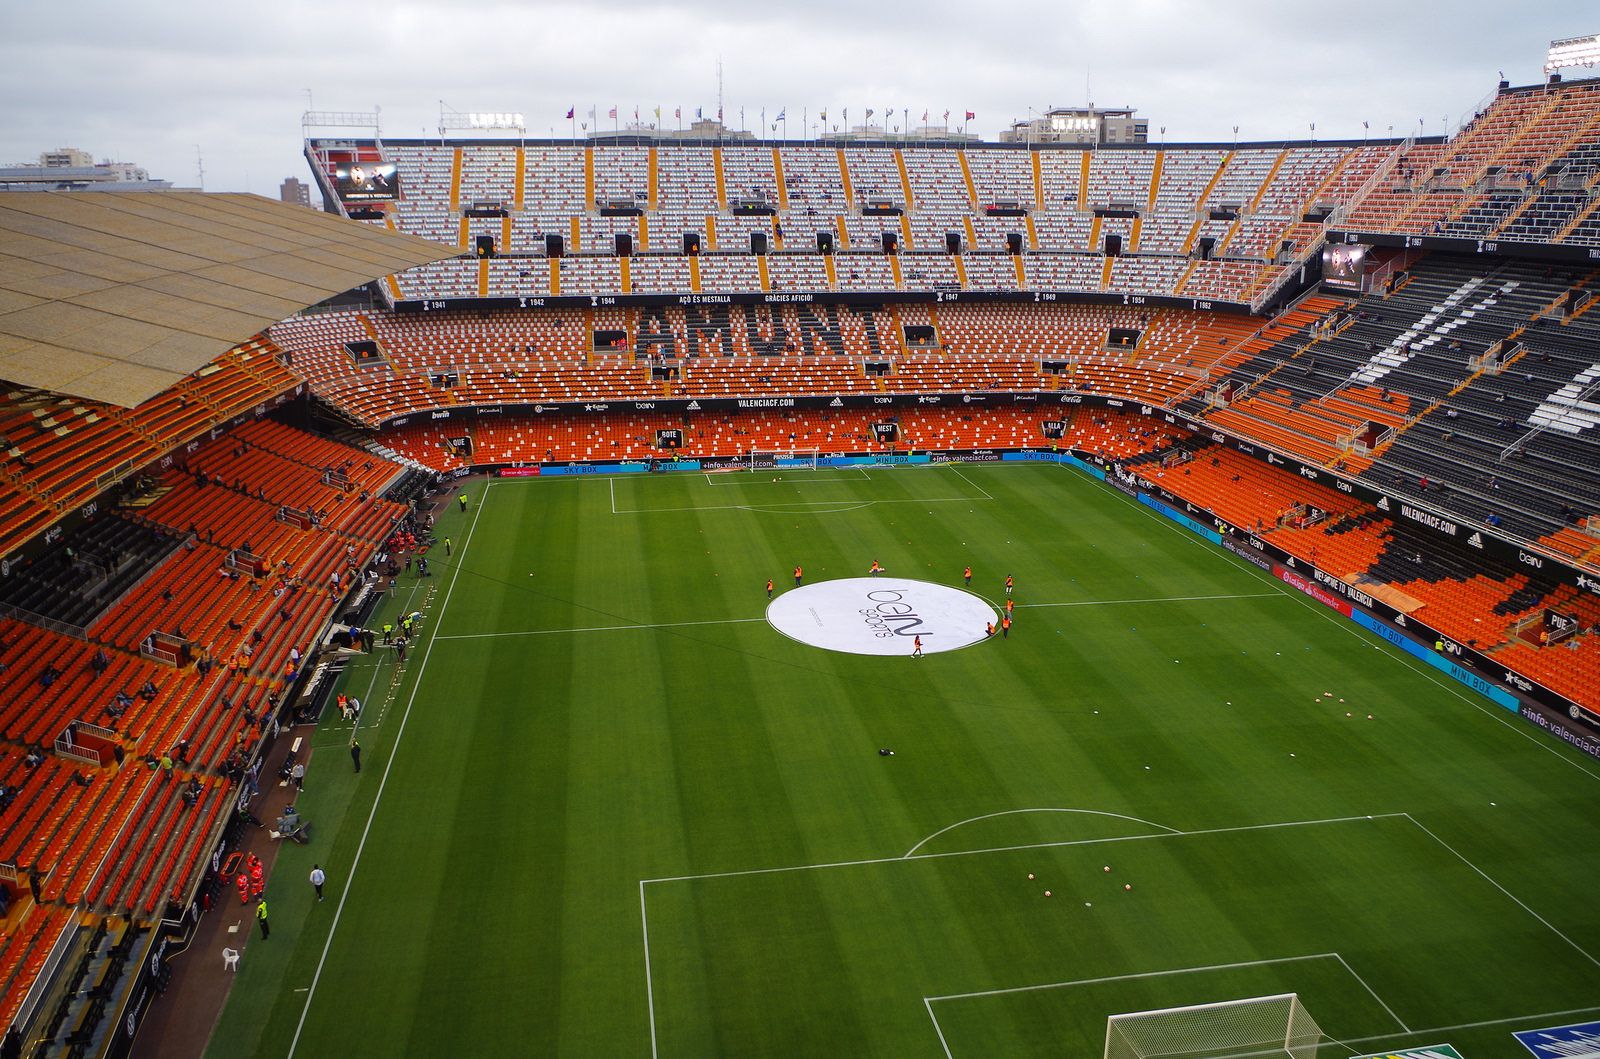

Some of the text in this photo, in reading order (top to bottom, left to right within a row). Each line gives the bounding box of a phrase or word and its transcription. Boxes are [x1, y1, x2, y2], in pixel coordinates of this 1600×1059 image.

[601, 297, 615, 305] 1944
[701, 295, 731, 304] MESTALLA
[432, 301, 446, 309] 1941
[738, 399, 795, 408] VALENCIACF.COM
[431, 410, 450, 420] bwin
[661, 430, 677, 438] BOTE
[453, 438, 465, 446] QUE
[952, 454, 998, 462] valenciacf.com
[662, 463, 678, 471] BOX
[723, 461, 773, 469] valenciacf.com
[1400, 504, 1457, 536] VALENCIACF.COM
[1347, 586, 1373, 609] VALENCIA
[1551, 614, 1568, 631] PUE
[1371, 621, 1404, 647] SKY BOX
[1450, 664, 1491, 695] MINI BOX
[1521, 706, 1549, 729] +info:
